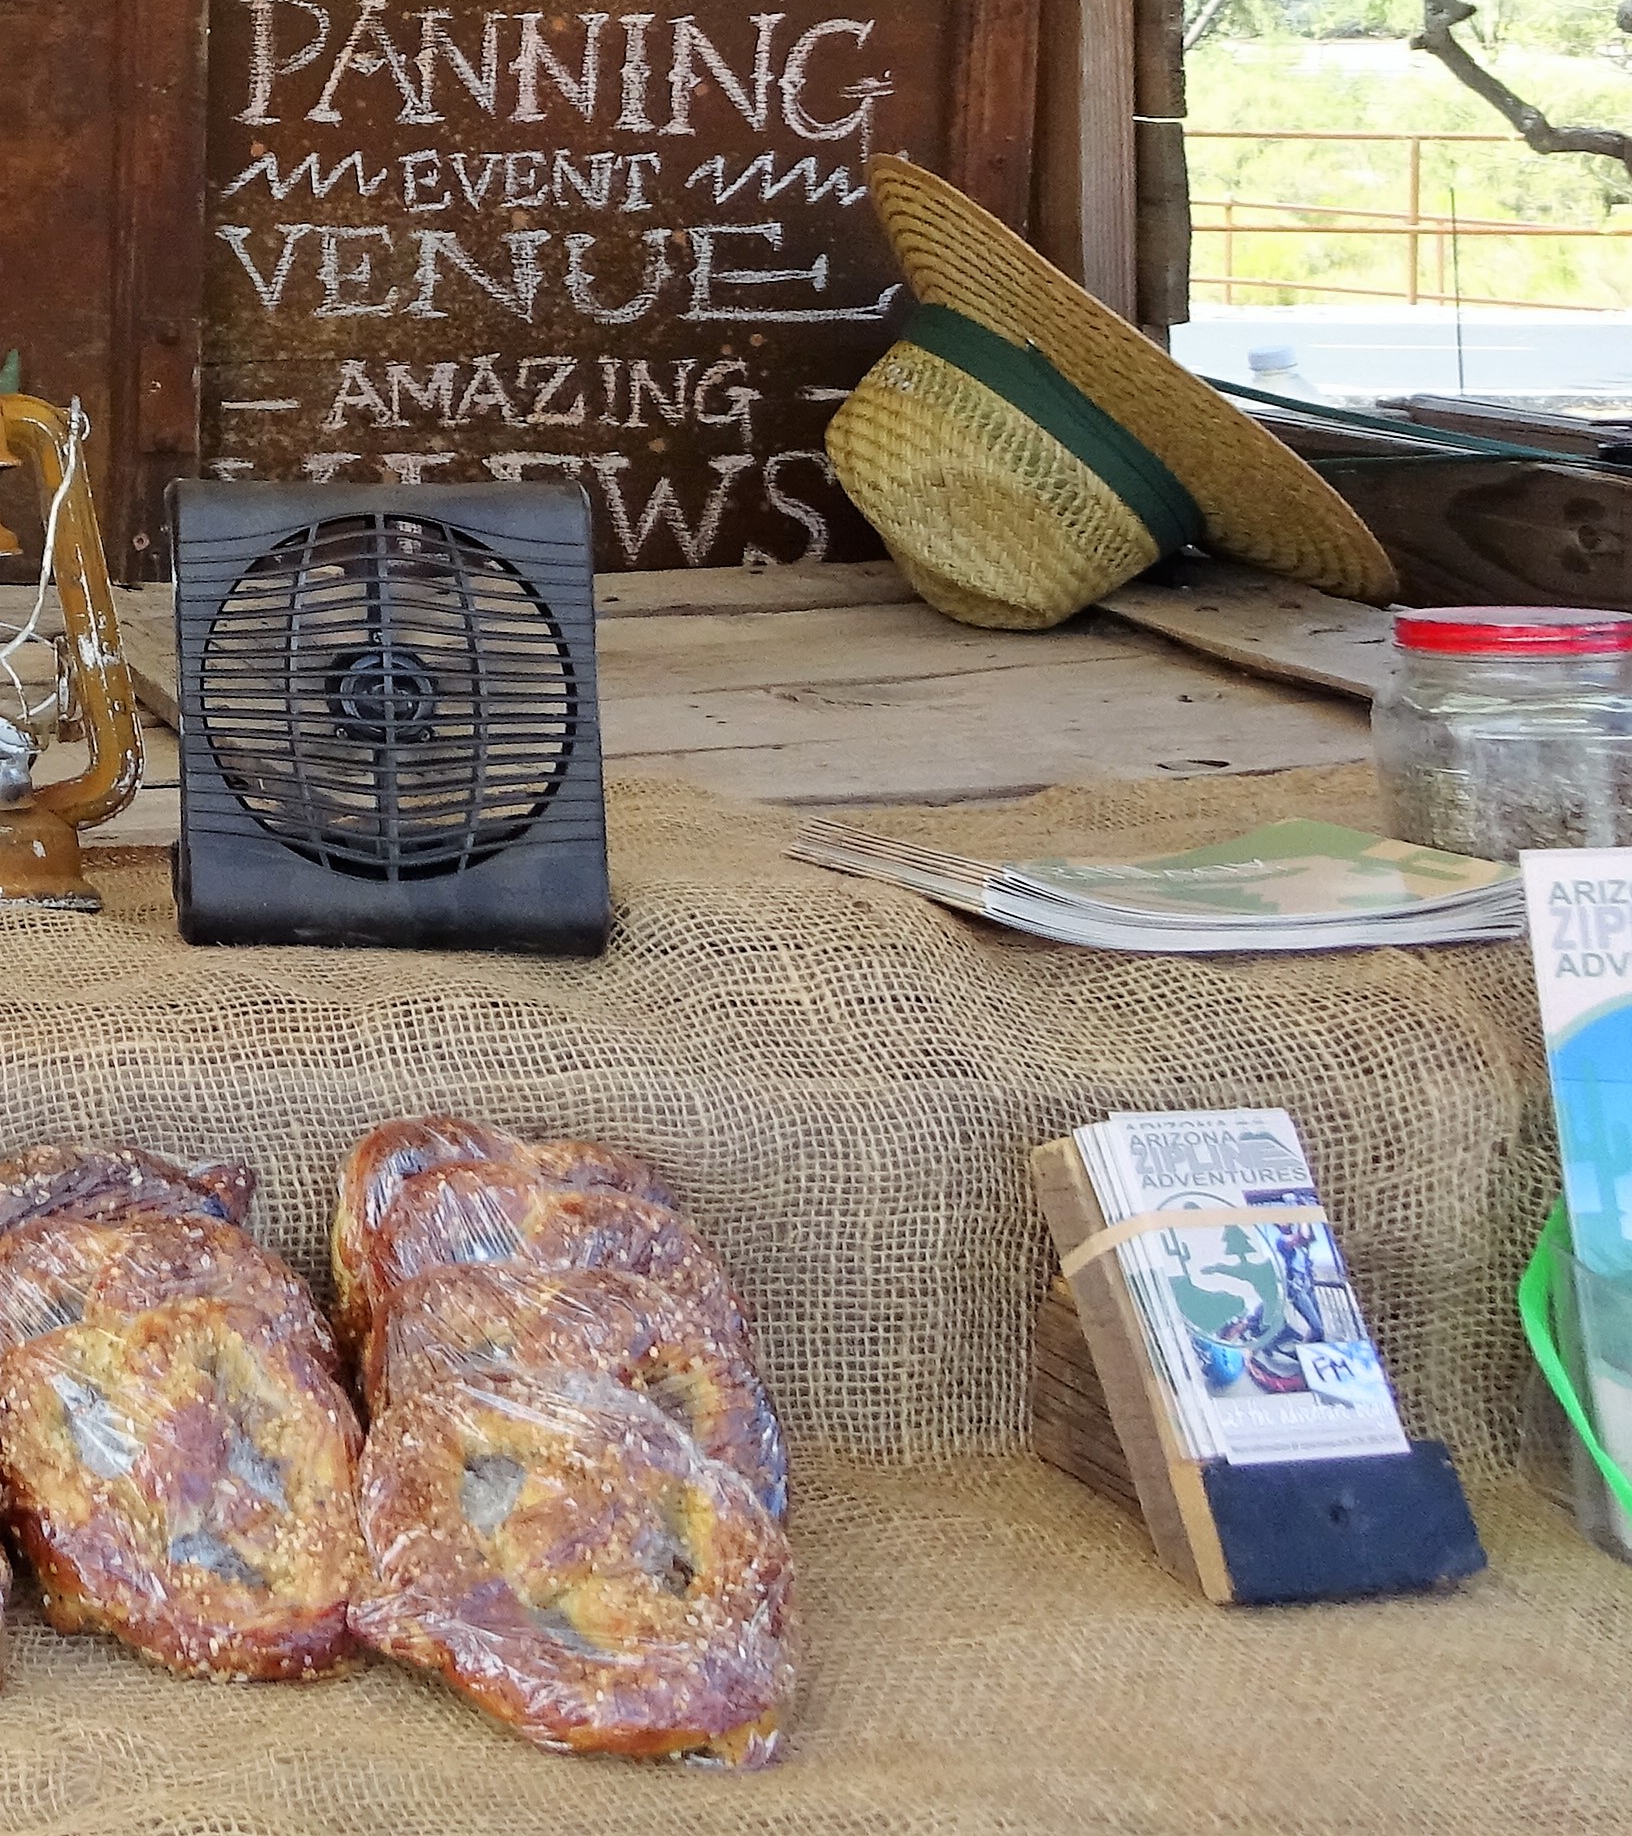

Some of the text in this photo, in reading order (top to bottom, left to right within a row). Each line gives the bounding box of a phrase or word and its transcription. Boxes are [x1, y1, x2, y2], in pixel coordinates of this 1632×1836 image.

[403, 149, 663, 213] EVENT
[216, 221, 903, 323] VENUE
[327, 351, 762, 442] AMAZING
[1549, 879, 1632, 904] ARIZ
[1550, 905, 1632, 949] ZIP
[1556, 952, 1632, 978] ADV
[1130, 1130, 1237, 1148] ARIZONA
[1142, 1167, 1308, 1189] ADVENTURES
